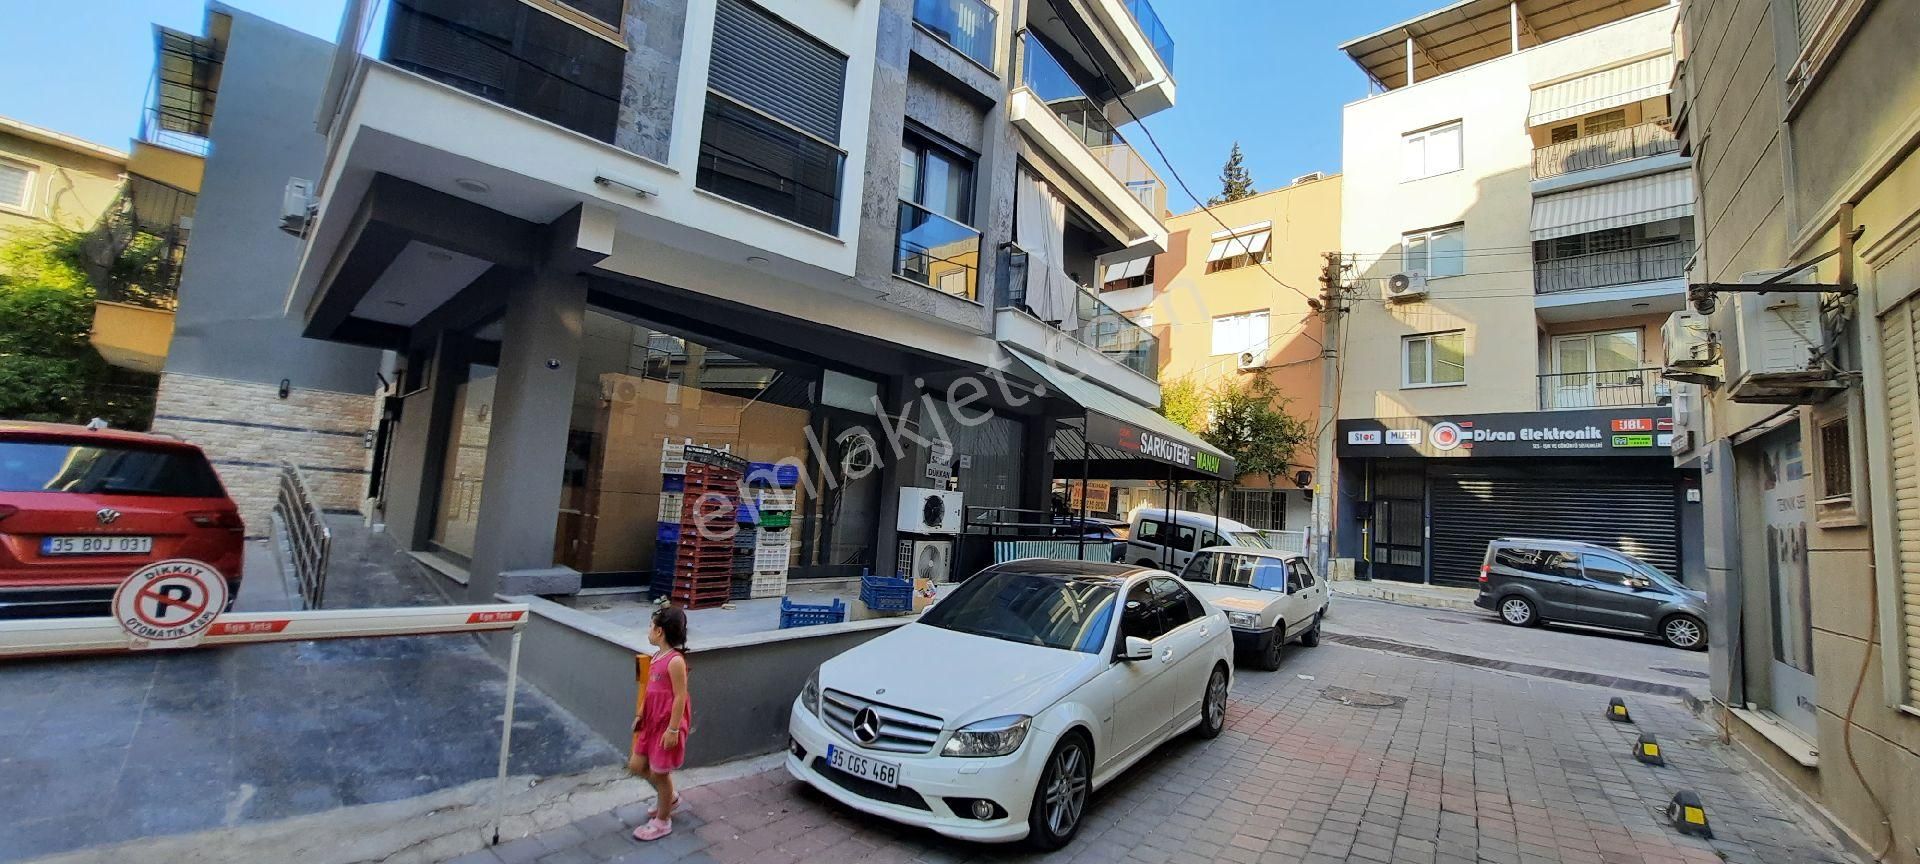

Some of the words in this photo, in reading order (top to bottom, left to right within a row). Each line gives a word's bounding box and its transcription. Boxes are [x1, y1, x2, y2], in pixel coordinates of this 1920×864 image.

[1474, 429, 1516, 442] Disan
[1519, 426, 1602, 441] Elektronik
[1195, 452, 1220, 474] MANAV
[928, 467, 950, 479] DÜKKAN
[53, 538, 73, 551] 35
[120, 538, 148, 551] 031
[144, 565, 203, 580] DİKKAT
[832, 749, 844, 767] 35
[847, 755, 868, 776] CGS
[872, 763, 896, 784] 468
